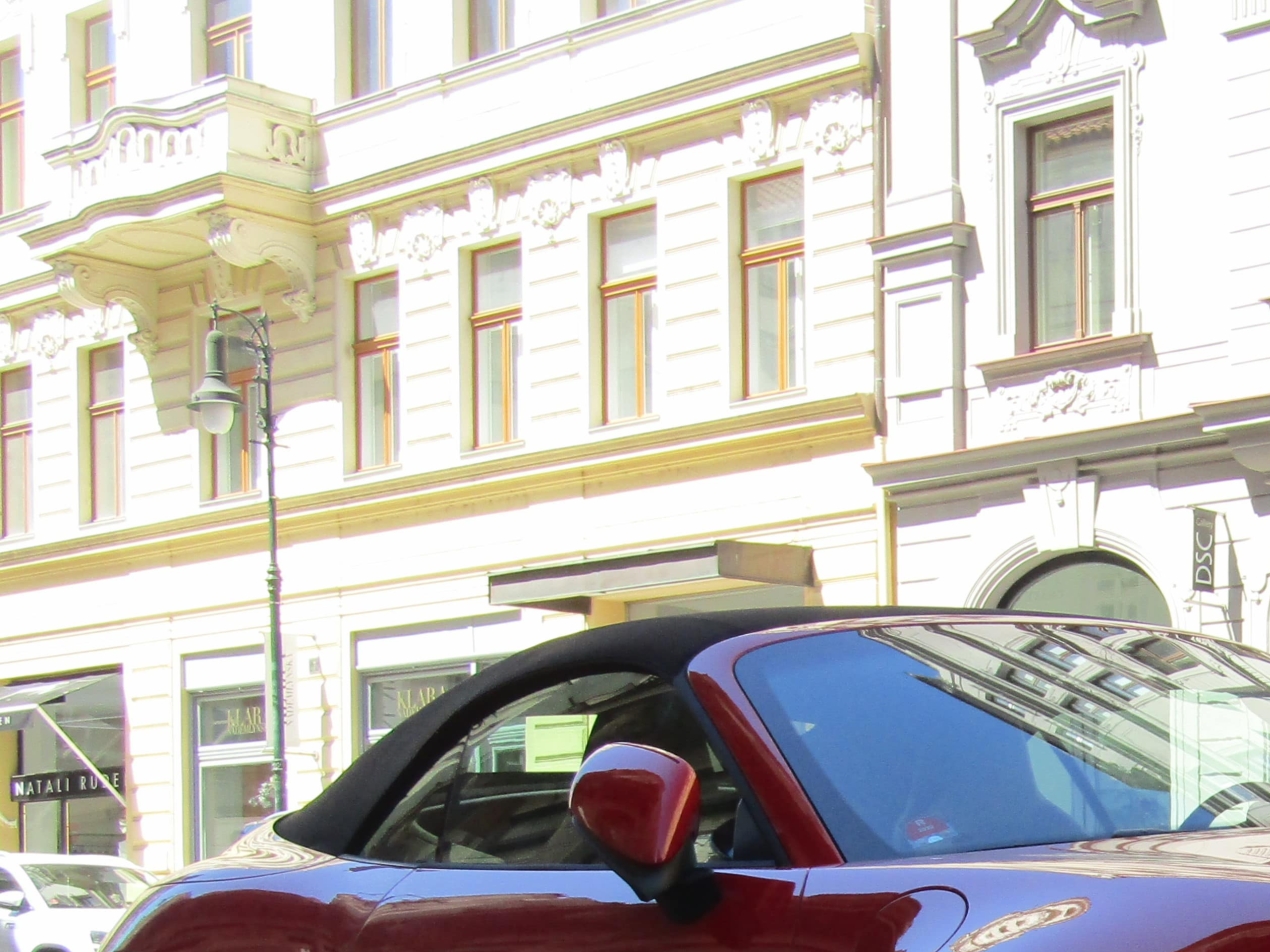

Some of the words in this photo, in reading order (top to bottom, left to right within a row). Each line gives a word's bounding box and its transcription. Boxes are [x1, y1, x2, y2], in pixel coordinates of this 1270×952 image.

[1195, 531, 1213, 585] DSC
[227, 706, 263, 727] KLAR
[15, 777, 70, 796] NATALI
